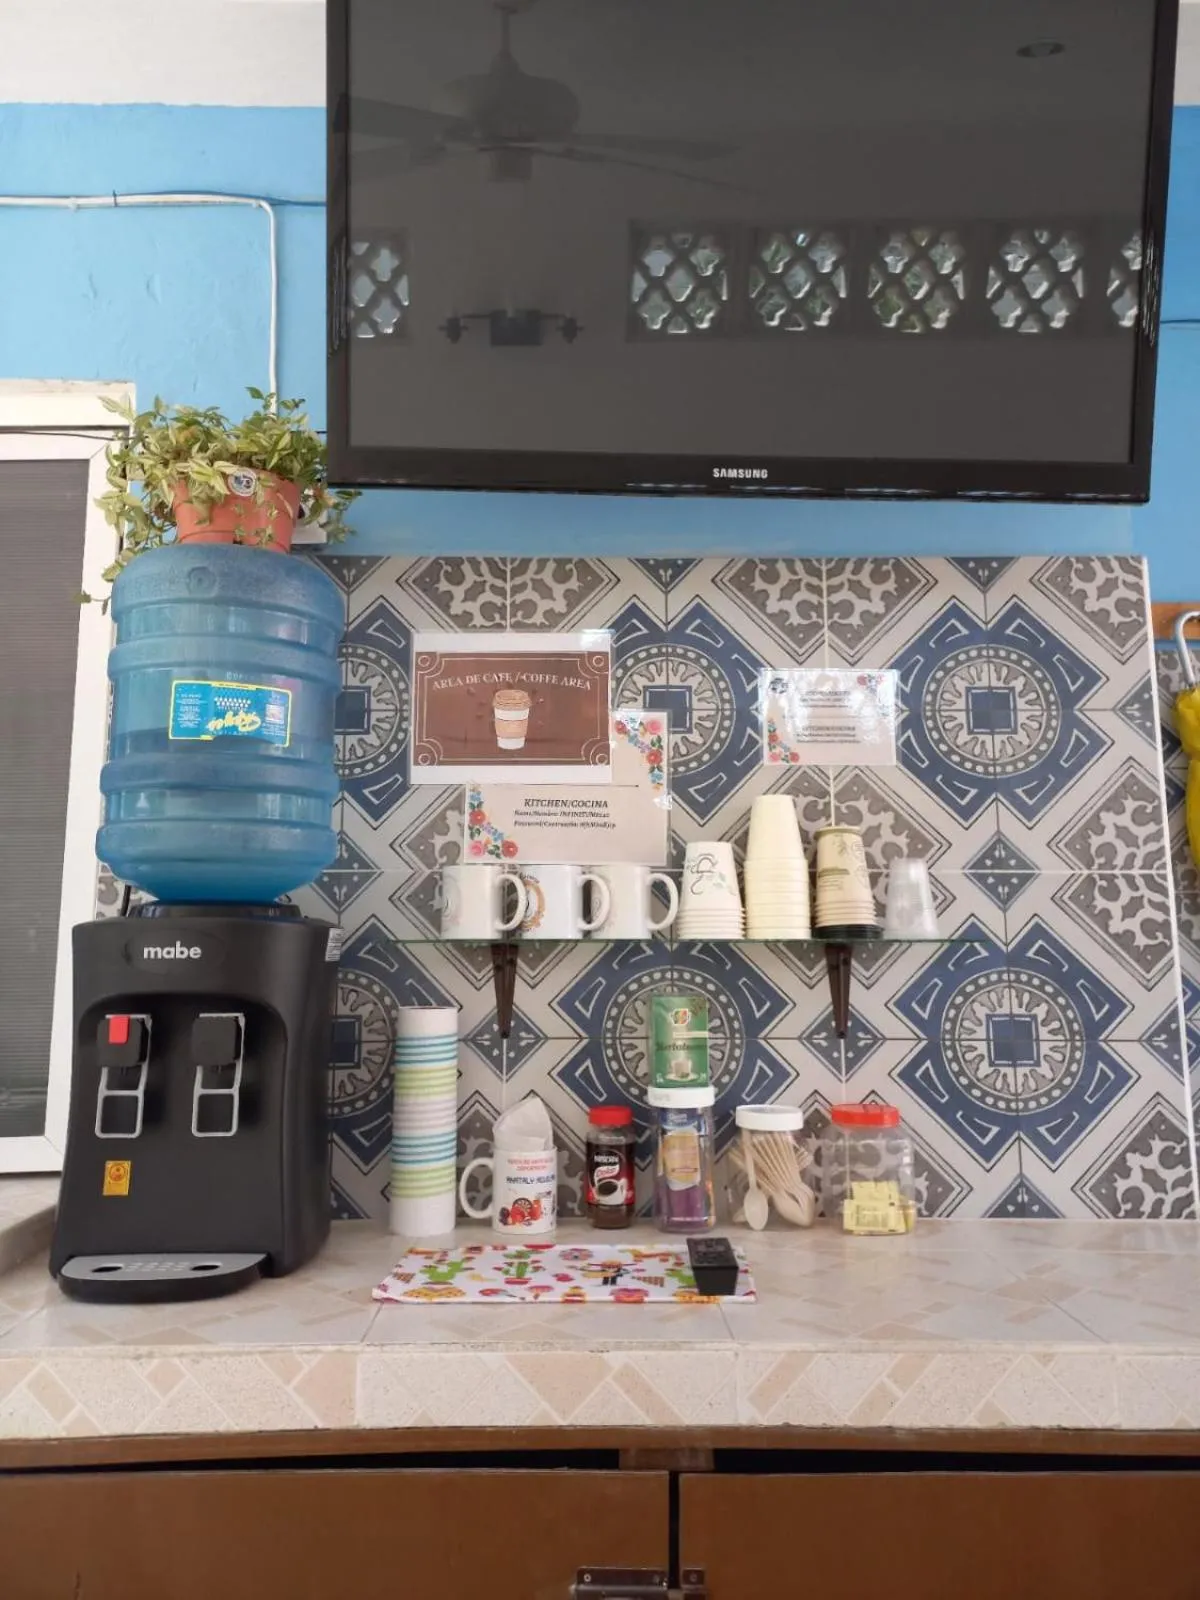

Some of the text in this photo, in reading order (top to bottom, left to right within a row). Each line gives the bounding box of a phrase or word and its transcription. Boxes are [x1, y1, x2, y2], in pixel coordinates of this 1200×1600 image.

[712, 467, 768, 479] SAMSUNG
[433, 676, 464, 690] AREA
[465, 674, 481, 684] DE
[560, 676, 591, 690] AREA
[143, 940, 202, 959] mabe
